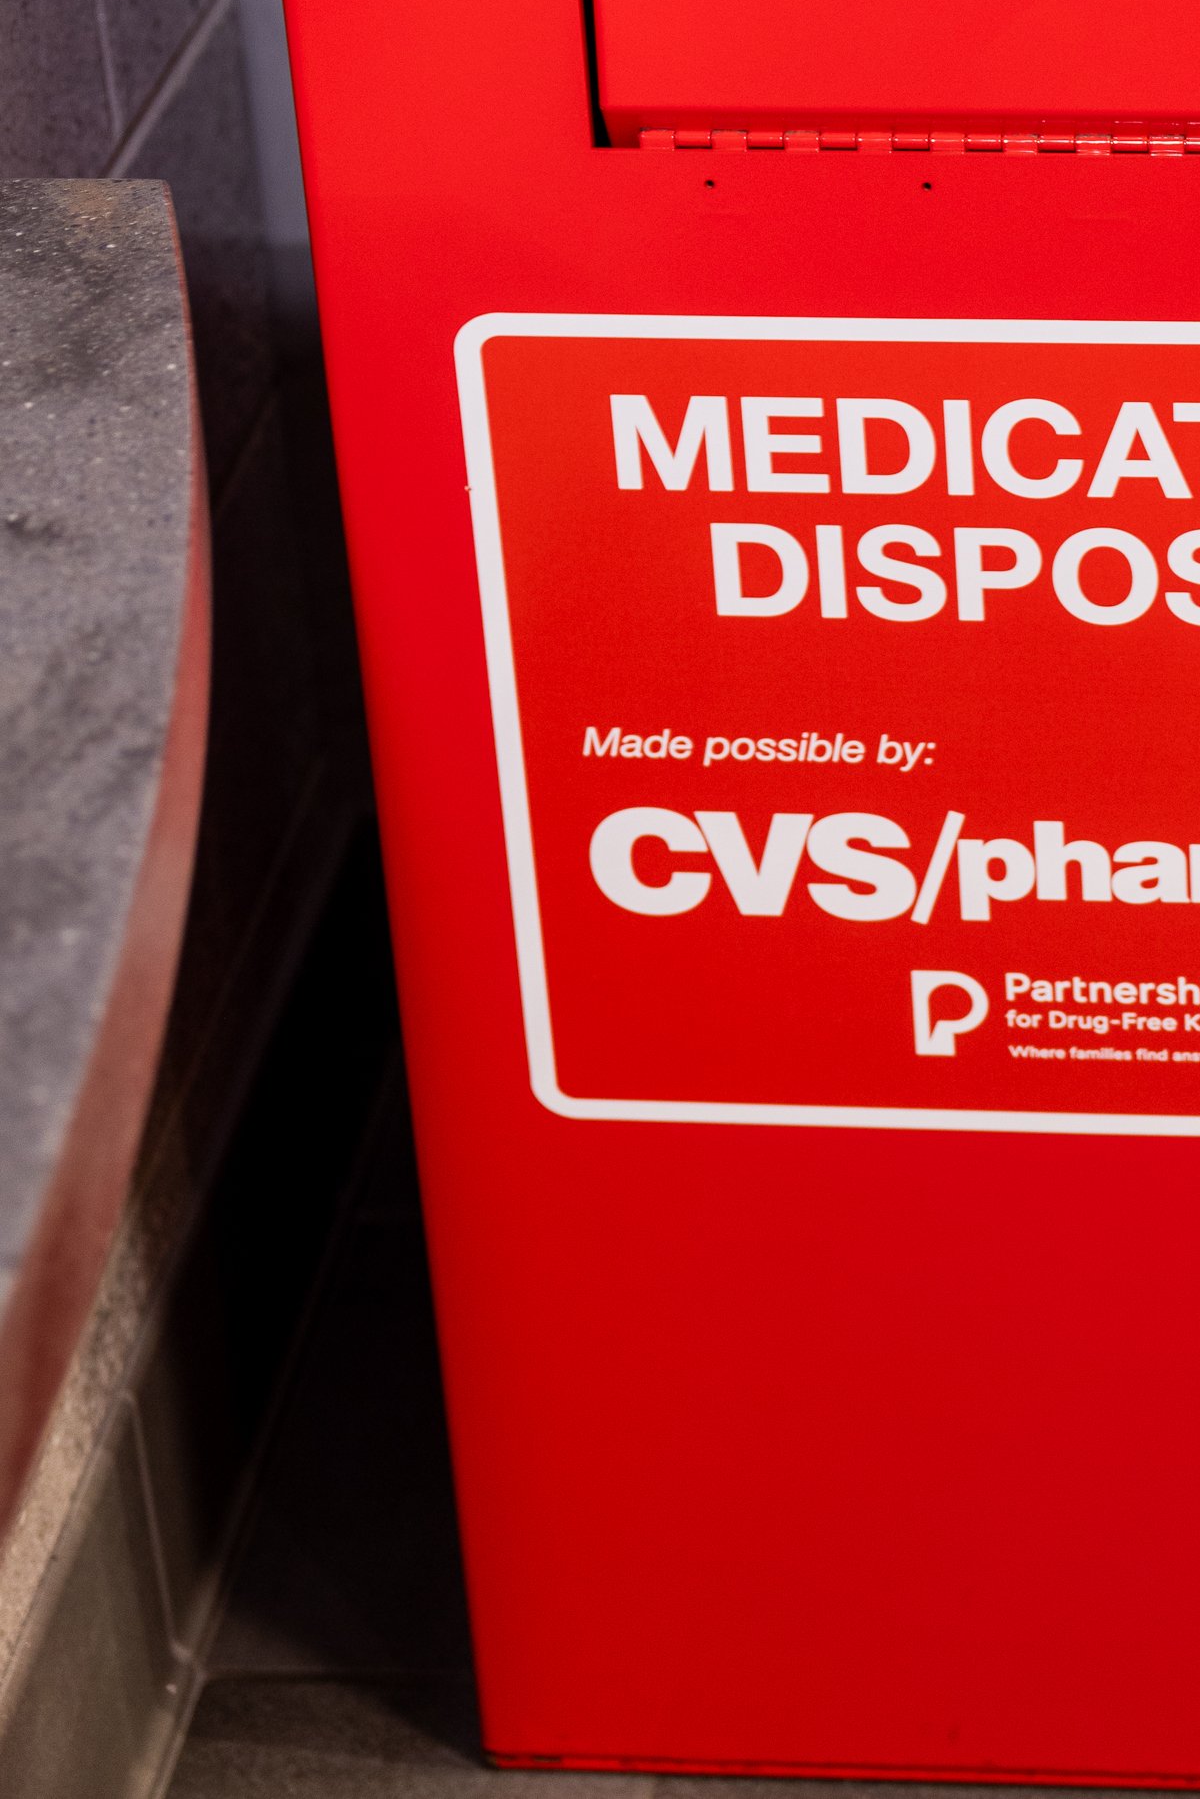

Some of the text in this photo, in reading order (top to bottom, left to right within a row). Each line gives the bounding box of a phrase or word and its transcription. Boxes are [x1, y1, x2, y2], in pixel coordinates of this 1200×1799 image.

[583, 727, 936, 772] Made possible by:
[1005, 1010, 1042, 1028] for
[1049, 1010, 1177, 1034] Drug-Free
[1008, 1045, 1066, 1059] Where
[1069, 1047, 1132, 1061] families
[1136, 1048, 1168, 1061] find
